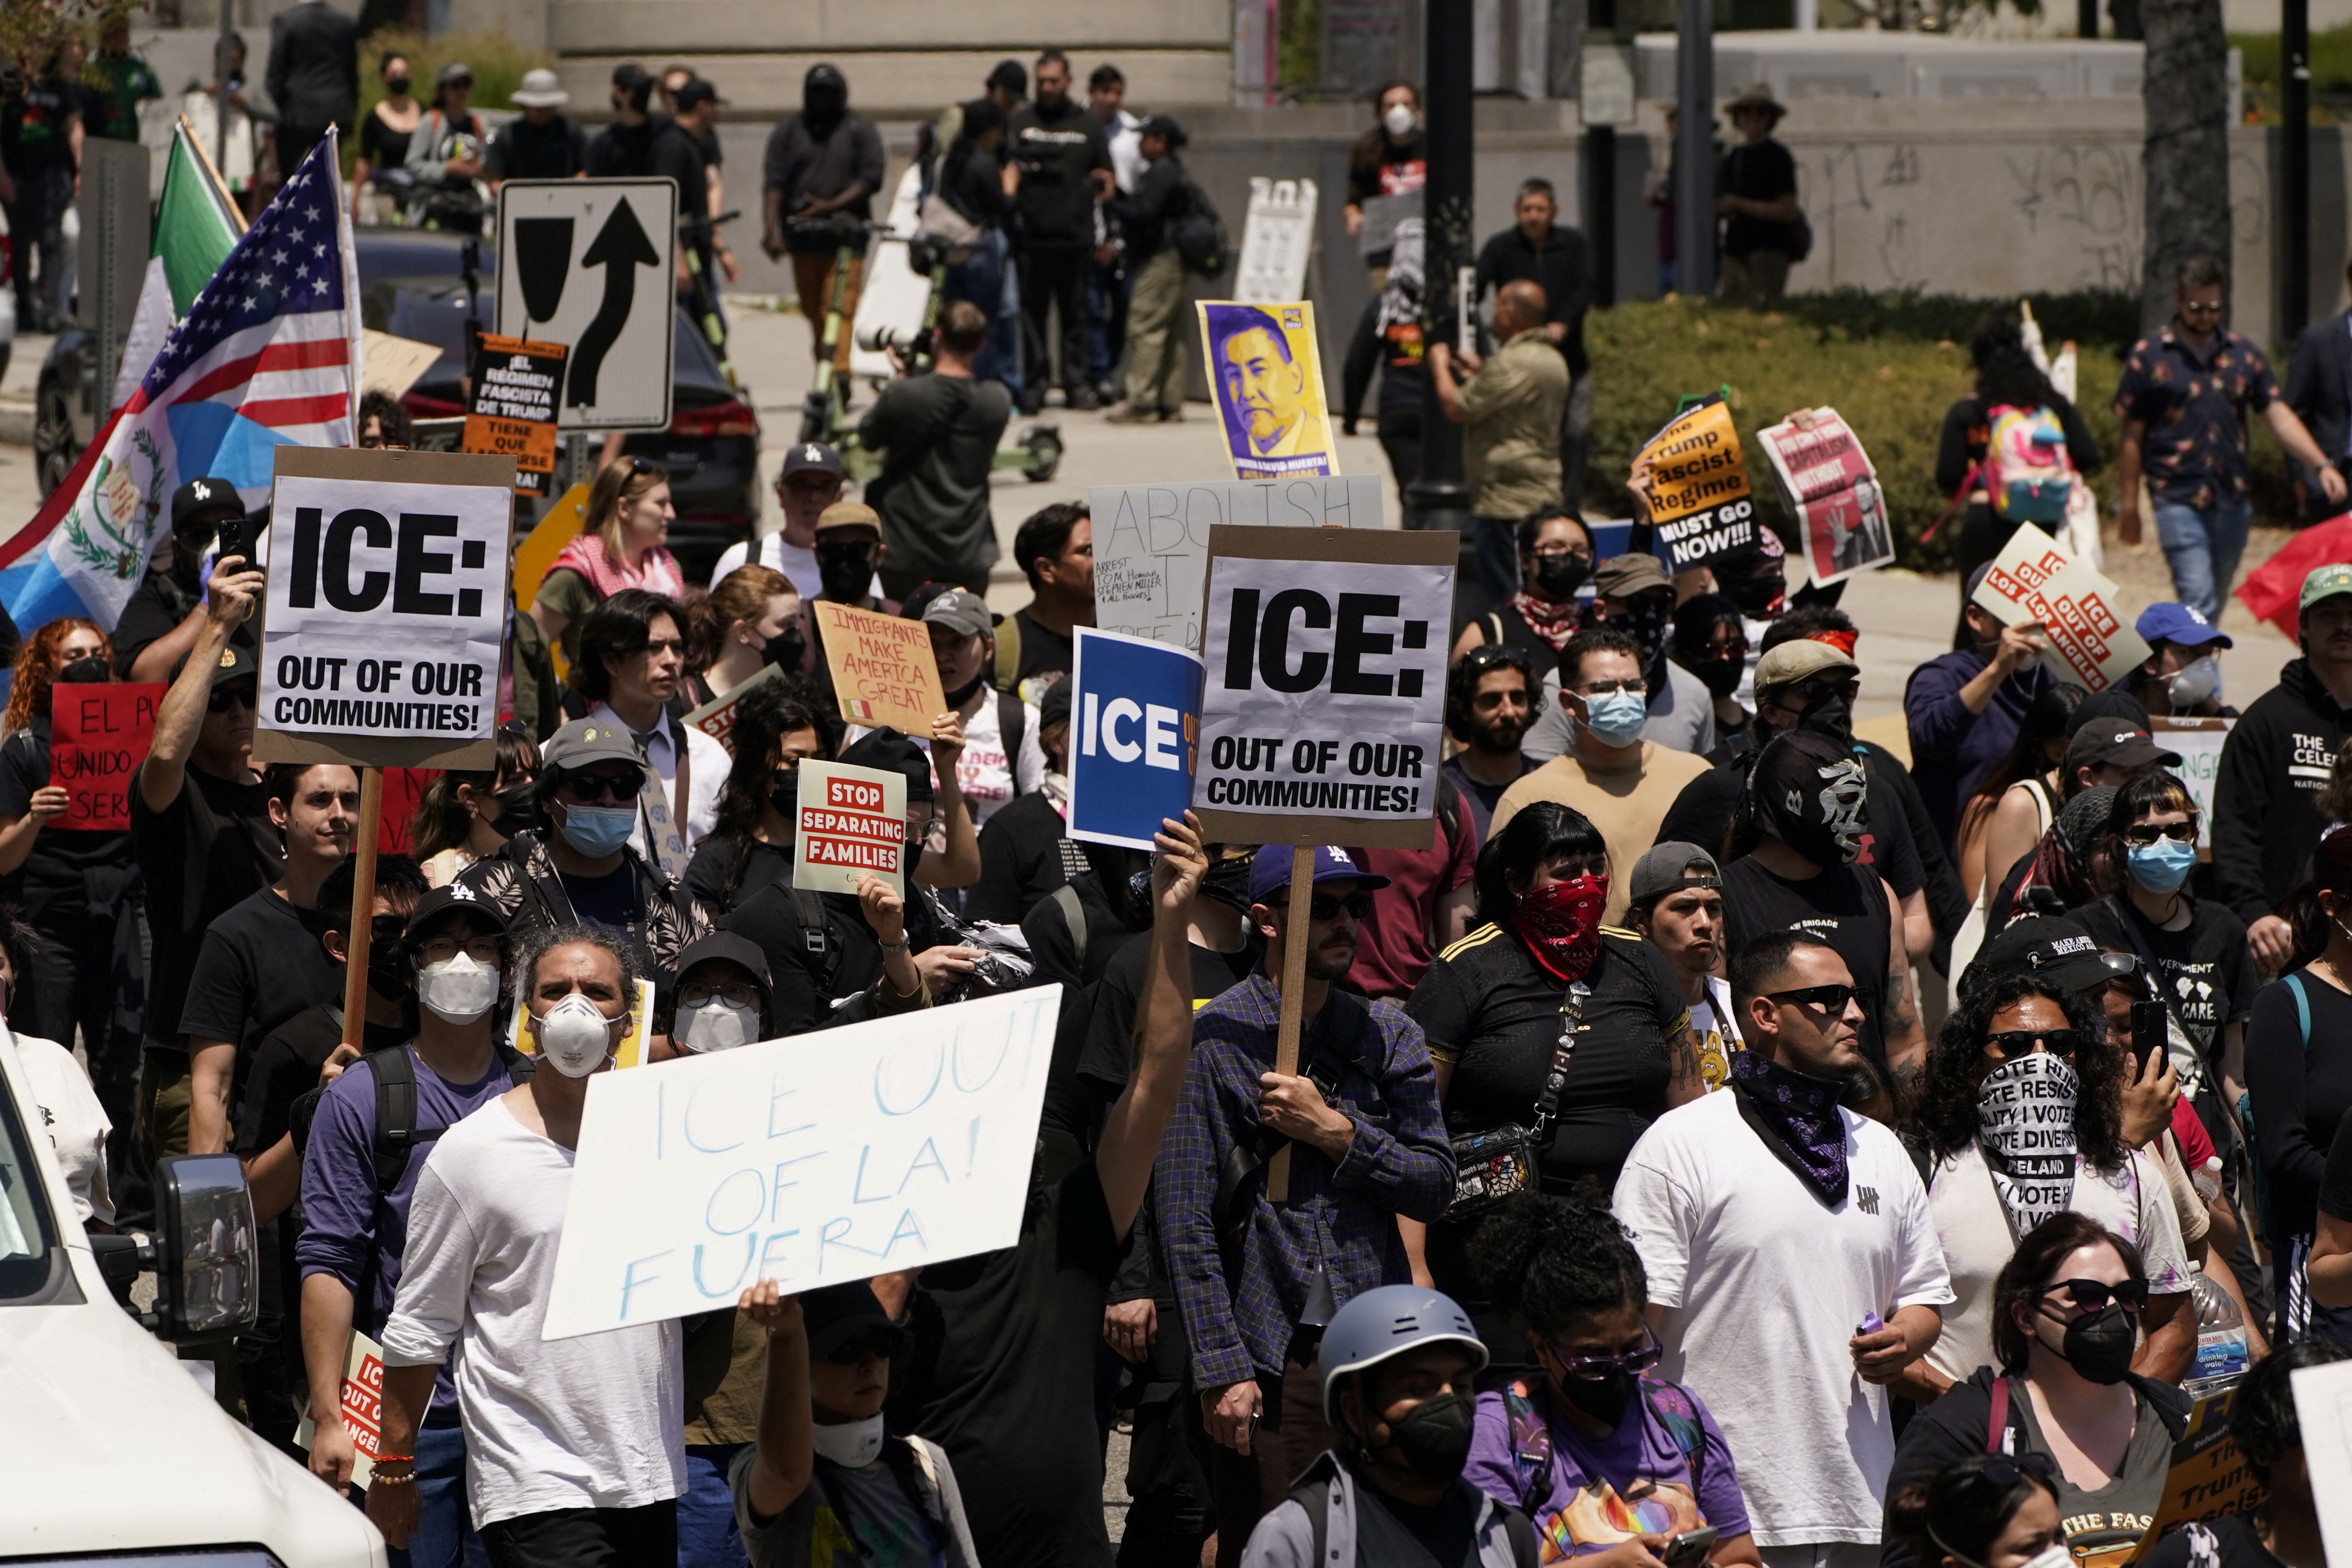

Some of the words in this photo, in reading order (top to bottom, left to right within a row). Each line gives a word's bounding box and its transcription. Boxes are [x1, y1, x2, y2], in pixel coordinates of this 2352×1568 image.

[510, 355, 532, 371] ¡EL
[486, 367, 554, 389] RÉGIMEN
[480, 383, 552, 405] FASCISTA
[476, 399, 498, 414] DE
[500, 402, 552, 422] TRUMP
[488, 421, 532, 437] TIENE
[495, 436, 526, 449] QUE
[1651, 447, 1735, 489] ascist
[193, 481, 211, 501] LA
[1652, 475, 1742, 513] Regime
[1659, 511, 1713, 543] MUST
[1718, 500, 1752, 524] GO
[1672, 521, 1752, 565] NOW!!!
[289, 507, 486, 617] ICE:
[1096, 557, 1132, 574] ARREST
[2044, 555, 2067, 576] IC
[1095, 573, 1122, 586] TOM
[1097, 581, 1133, 597] STEPHEN
[1135, 578, 1162, 590] MILLER
[1989, 571, 2018, 596] LOS
[827, 607, 928, 649] IMMIGRANTS
[2056, 600, 2087, 632] OUT
[2083, 635, 2105, 657] OF
[2083, 597, 2114, 633] ICE
[859, 636, 908, 662] MAKE
[1224, 588, 1429, 698] ICE:
[2028, 594, 2054, 625] LOS
[2048, 627, 2104, 690] ANGELES
[277, 655, 347, 691] OUT
[357, 659, 402, 693] OF
[411, 662, 484, 697] OUR
[843, 653, 927, 687] AMERICA
[857, 678, 925, 714] GREAT
[81, 699, 120, 733] EL
[136, 696, 159, 726] PU
[275, 696, 479, 731] COMMUNITIES!
[704, 704, 737, 735] STO
[1082, 692, 1179, 771] ICE
[2292, 733, 2325, 751] THE
[57, 749, 132, 779] UNIDO
[1211, 736, 1284, 772] OUT
[1292, 740, 1340, 774] OF
[1348, 742, 1424, 779] OUR
[831, 783, 881, 807] STOP
[1207, 777, 1419, 813] COMMUNITIES!
[803, 812, 903, 840] SEPARATING
[809, 841, 897, 869] FAMILIES
[1328, 845, 1351, 863] LA
[450, 883, 476, 901] LA
[1802, 919, 1838, 929] BRIGADE
[2051, 938, 2076, 949] MAKE
[2056, 943, 2085, 956] MEXICO
[2086, 941, 2098, 951] AGA
[2159, 957, 2215, 974] VERNMENT
[1564, 1006, 1582, 1019] BLK-GLD
[2181, 1002, 2217, 1021] CARE.
[655, 1067, 818, 1163] ICE
[874, 996, 1058, 1116] OUT
[1980, 1107, 2018, 1128] ALITY
[2023, 1107, 2027, 1123] I
[2033, 1105, 2069, 1124] VOTE
[706, 1149, 829, 1236] OF
[853, 1115, 982, 1205] LA!
[2018, 1186, 2062, 1205] VOTE
[620, 1208, 928, 1322] FUERA
[2198, 1353, 2228, 1363] drinking
[362, 1361, 384, 1389] IC
[341, 1384, 371, 1412] OUT
[372, 1404, 381, 1420] O
[2193, 1424, 2230, 1450] RefuseF
[2209, 1441, 2236, 1468] Th
[2181, 1465, 2253, 1510] Trum
[2062, 1513, 2106, 1538] THE
[2110, 1512, 2155, 1531] FAS
